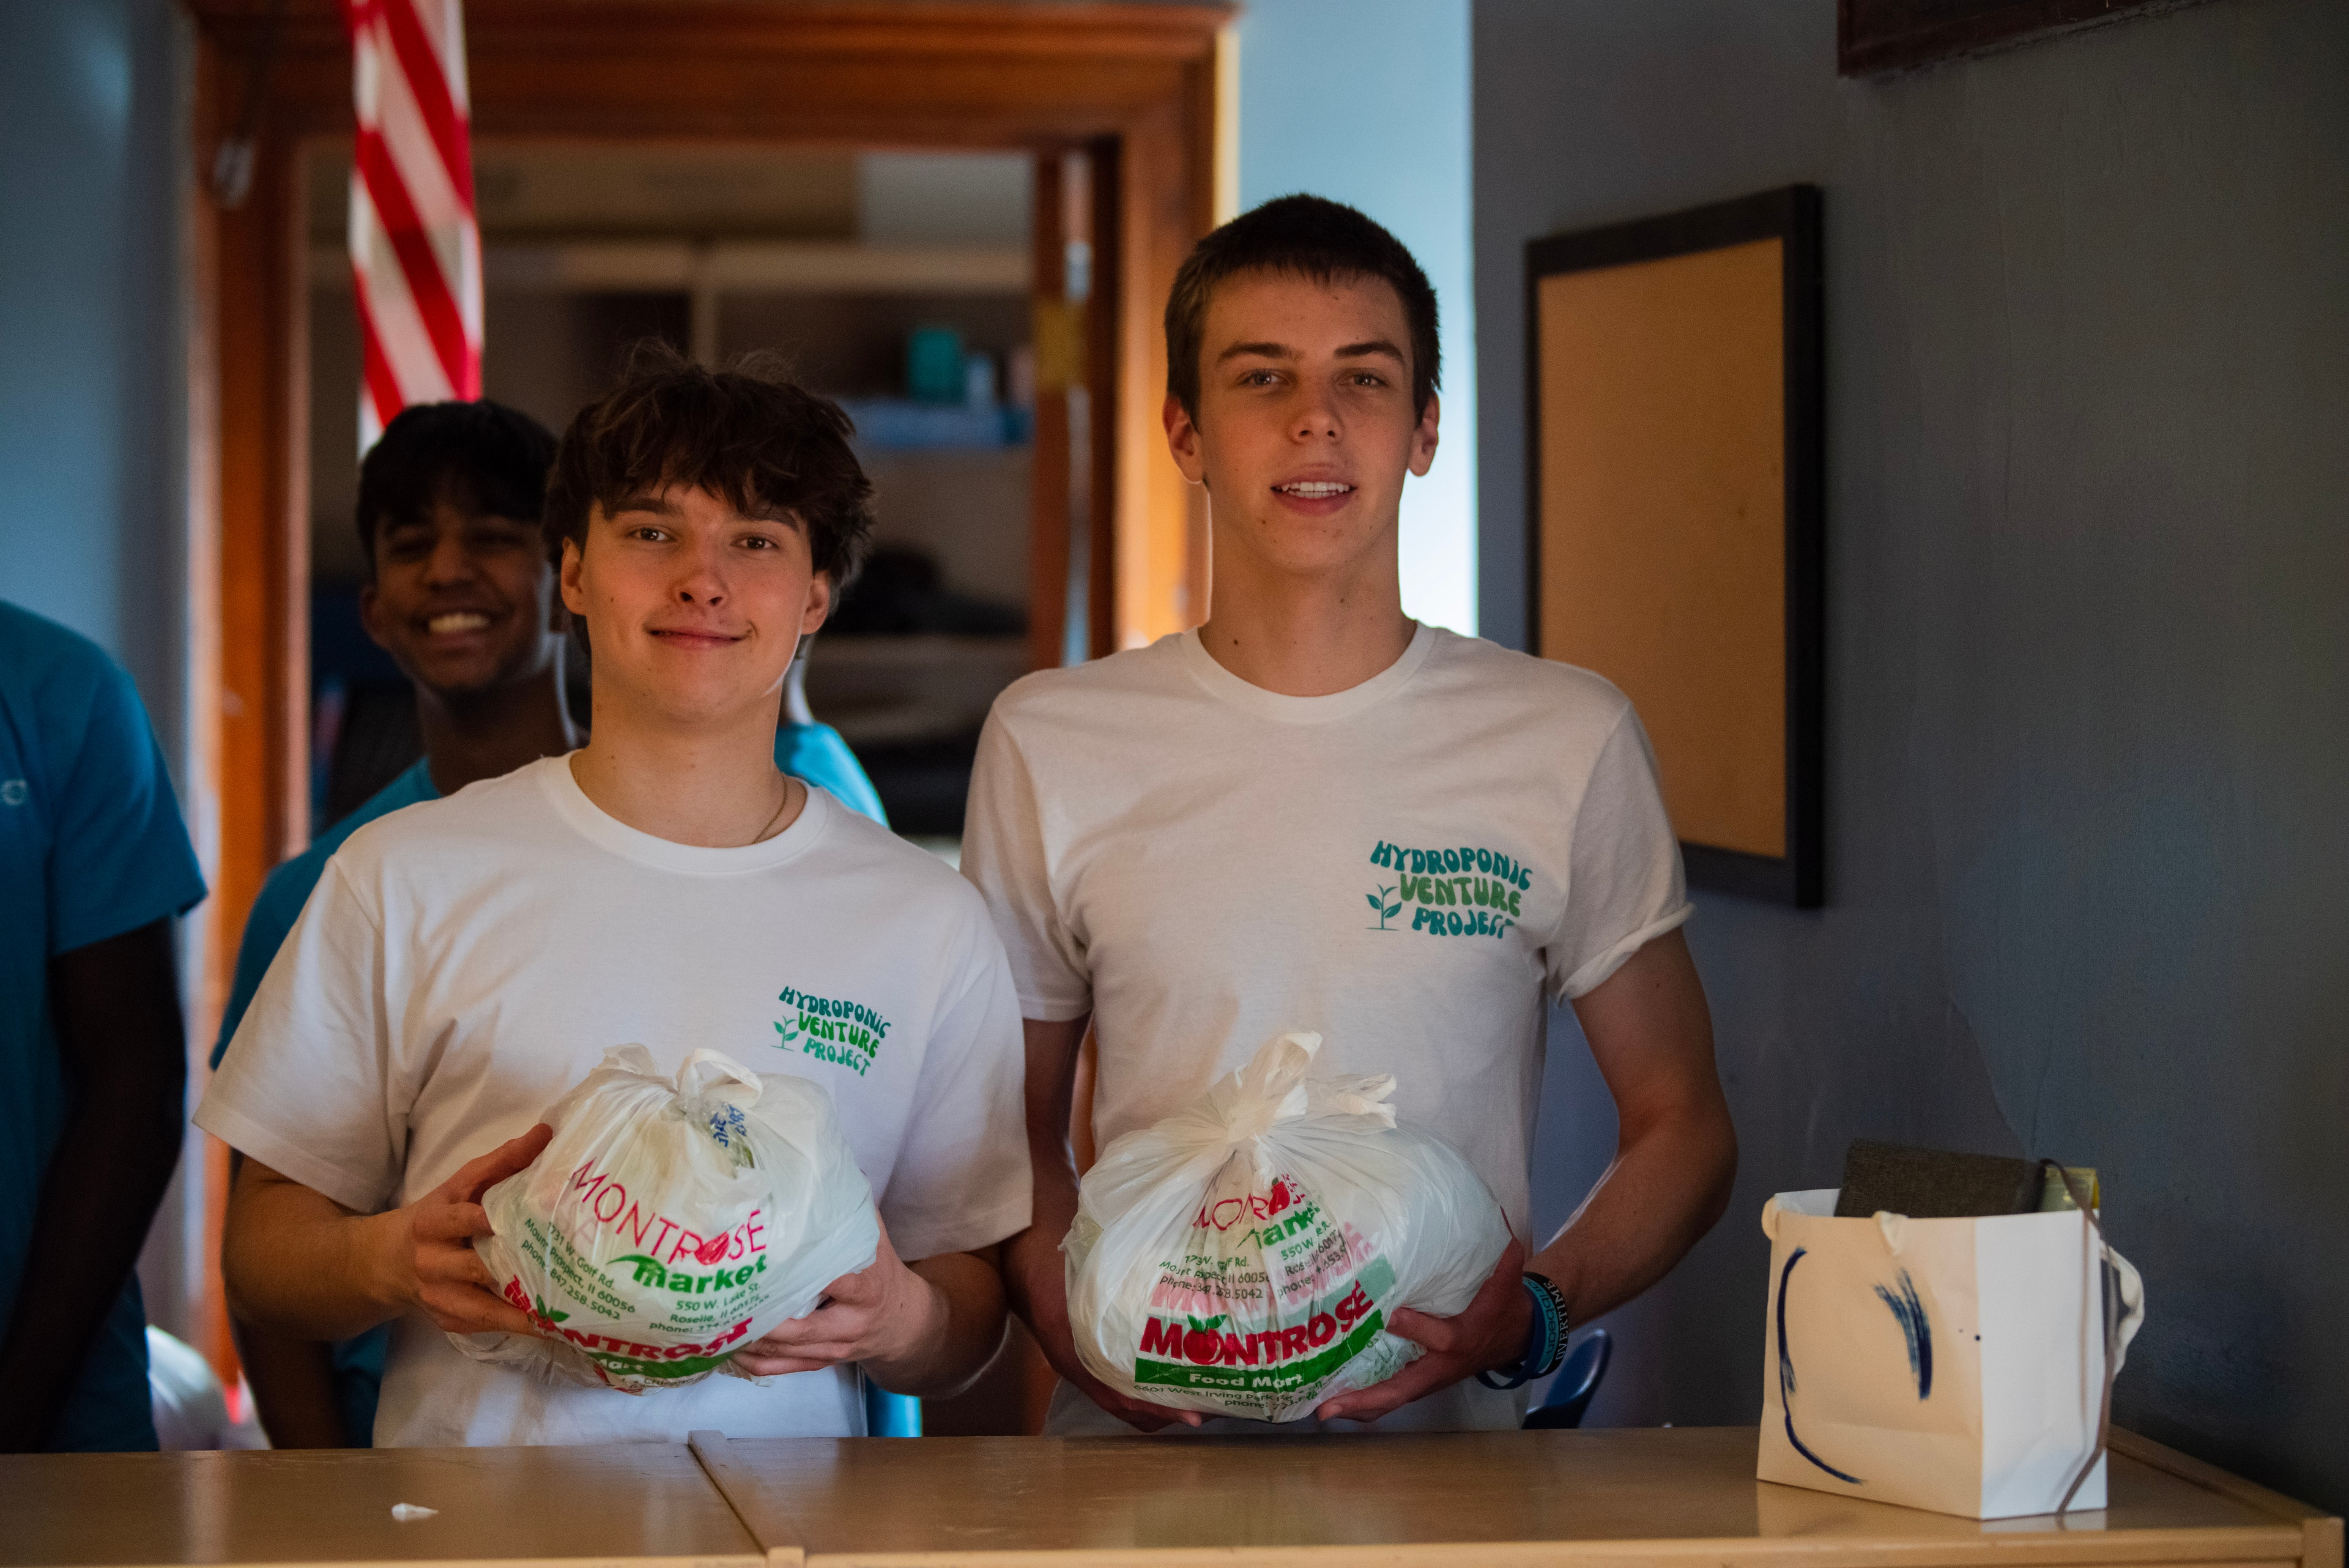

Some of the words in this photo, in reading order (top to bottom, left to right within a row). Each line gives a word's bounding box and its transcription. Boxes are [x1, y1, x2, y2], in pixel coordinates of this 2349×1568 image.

[1370, 840, 1533, 890] HYDROPONIC
[1400, 873, 1521, 918] VENTURE
[1412, 907, 1515, 939] PROJECT
[779, 986, 892, 1039] HYDROPONIC
[798, 1011, 880, 1058] VENTURE
[803, 1037, 871, 1077] PROJECT
[571, 1157, 766, 1265] MONTROSE
[577, 1257, 599, 1277] Golf
[597, 1273, 615, 1290] Rd.
[606, 1254, 766, 1295] market
[1234, 1255, 1250, 1268] Rd.
[597, 1290, 636, 1313] 60056
[676, 1299, 701, 1312] 550
[1543, 1280, 1568, 1361] OVERTIME
[1139, 1279, 1375, 1365] MONTROSE
[1134, 1384, 1164, 1393] 6601
[1167, 1387, 1202, 1397] West
[1205, 1391, 1243, 1400] Irving
[1246, 1393, 1274, 1402] Park
[1189, 1373, 1245, 1387] Food
[1252, 1374, 1304, 1389] Mart
